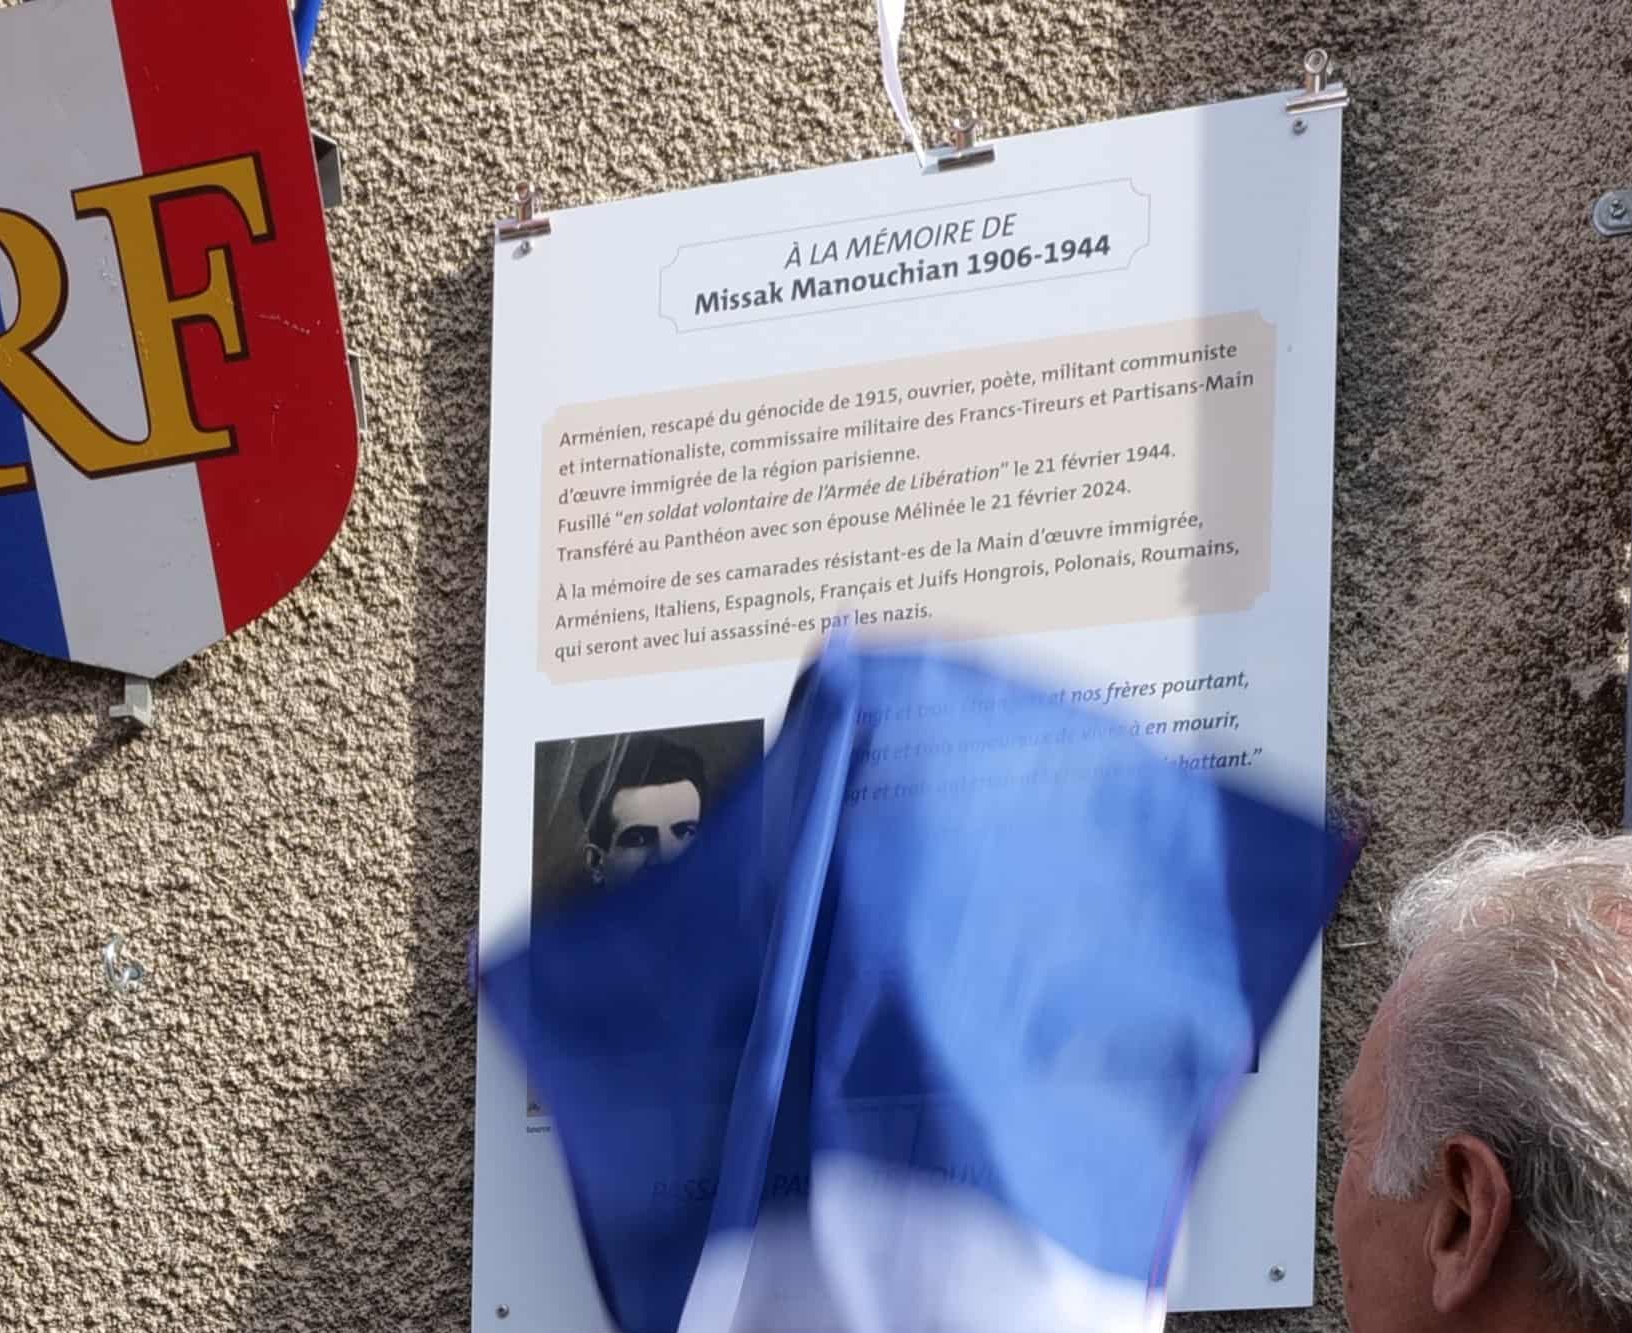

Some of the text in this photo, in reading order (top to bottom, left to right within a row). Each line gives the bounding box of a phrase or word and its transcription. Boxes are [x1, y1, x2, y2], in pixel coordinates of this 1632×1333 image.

[694, 233, 1111, 315] Missak Manouchian 1906-1944
[783, 212, 1017, 269] À LA MÉMOIRE DE
[558, 370, 1253, 476] et internationaliste, commissaire militaire des Francs-Tireurs et Partisans-Main
[559, 343, 1236, 447] Arménien, rescapé du génocide de 1915, ouvrier, poète, militant communiste
[558, 511, 610, 533] Fusillé
[646, 501, 698, 522] soldat
[703, 491, 788, 515] volontaire
[792, 487, 813, 504] de
[885, 475, 906, 492] de
[1014, 460, 1028, 476] le
[1034, 457, 1055, 474] 21
[1061, 450, 1120, 470] février
[1126, 442, 1175, 462] 1944.
[630, 471, 711, 495] immigrée
[716, 467, 737, 484] de
[742, 464, 756, 481] la
[762, 459, 816, 481] région
[822, 447, 919, 475] parisienne.
[555, 583, 567, 600] À
[571, 583, 585, 599] la
[590, 575, 666, 596] mémoire
[670, 570, 690, 587] de
[695, 570, 721, 584] ses
[725, 556, 818, 580] camarades
[824, 546, 925, 568] résistant-es
[929, 540, 951, 557] de
[956, 537, 971, 554] la
[977, 531, 1023, 552] Main
[1108, 511, 1203, 536] immigrée,
[556, 479, 1131, 562] Transféré au Panthéon avec son épouse Mélinée le 21 février 2024.
[555, 539, 1239, 629] Arméniens, Italiens, Espagnols, Français et Juifs Hongrois, Polonais, Roumains,
[554, 602, 932, 662] qui seront avec lui assassiné-es par les nazis.
[1071, 688, 1102, 703] nos
[1103, 682, 1156, 705] frères
[1161, 671, 1250, 699] pourtant,
[1145, 721, 1167, 736] en
[1171, 711, 1240, 733] mourir,
